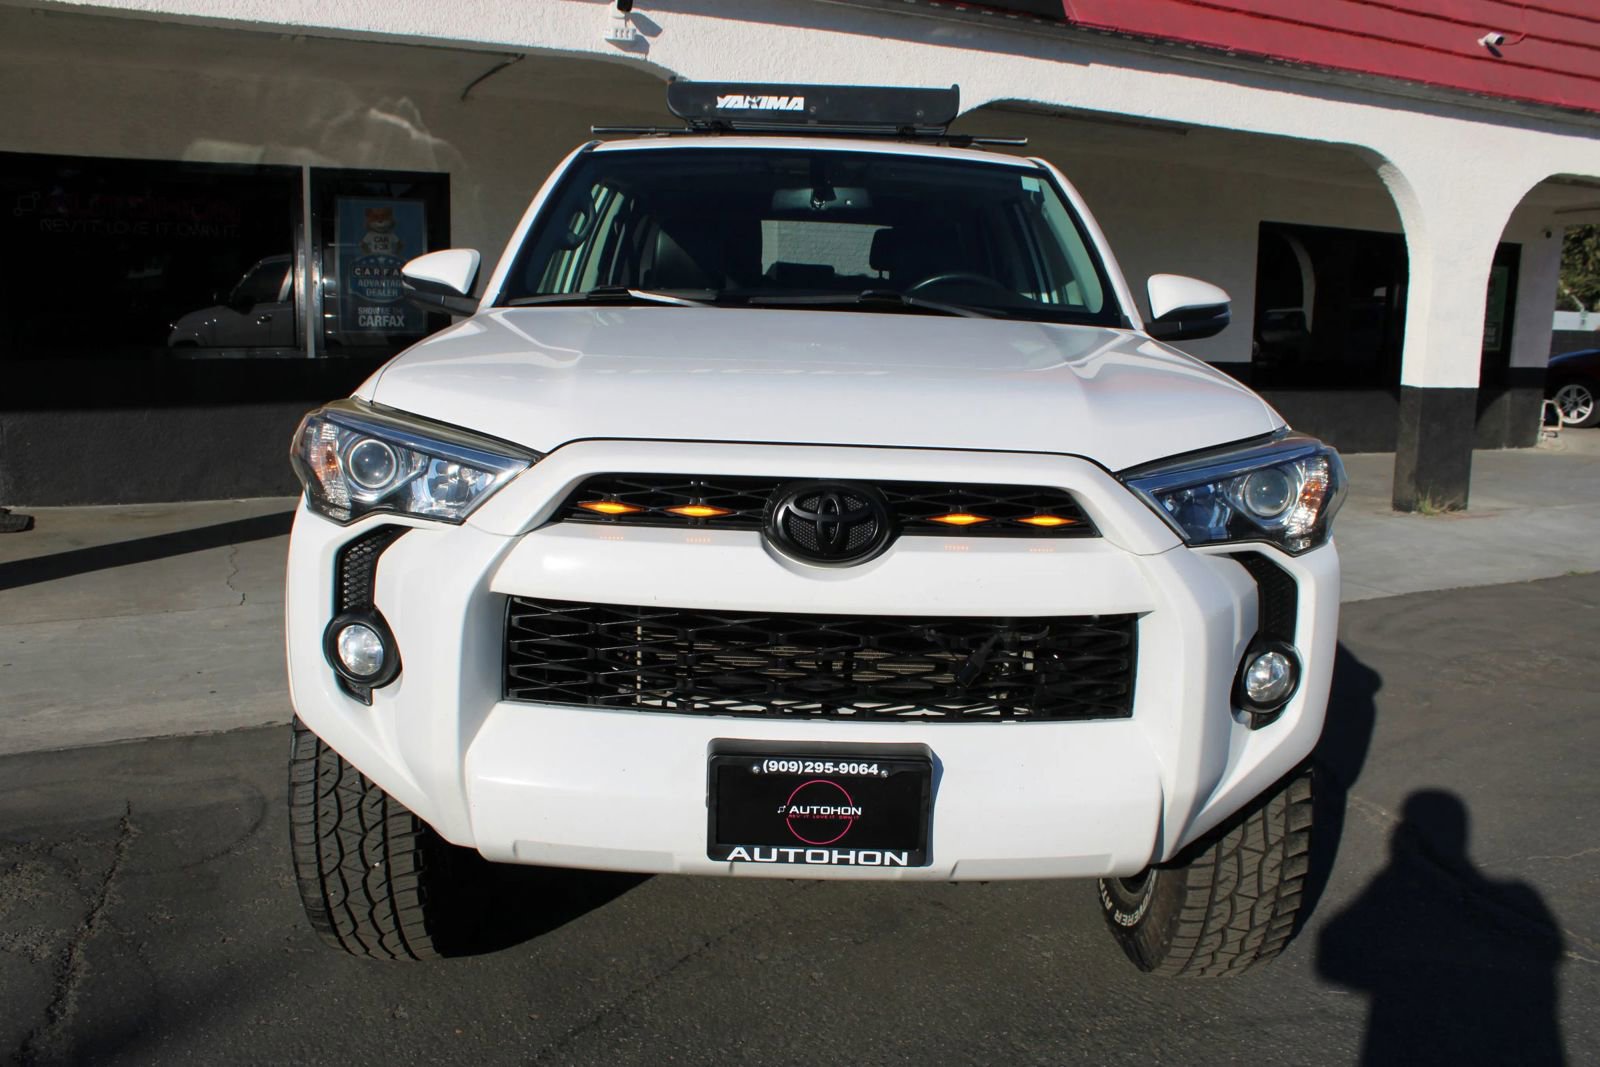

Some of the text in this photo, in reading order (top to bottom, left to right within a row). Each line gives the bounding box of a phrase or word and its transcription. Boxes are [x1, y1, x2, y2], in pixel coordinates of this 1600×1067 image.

[716, 94, 805, 111] YAKIMA
[354, 267, 403, 276] CARFA
[358, 279, 402, 287] ADVANTAG
[366, 288, 398, 297] DEALER
[358, 306, 380, 315] SHOW
[358, 315, 405, 328] CARFAX
[762, 760, 879, 776] (909)295-9064
[789, 805, 862, 816] AUTOHON
[726, 846, 909, 867] AUTOHON
